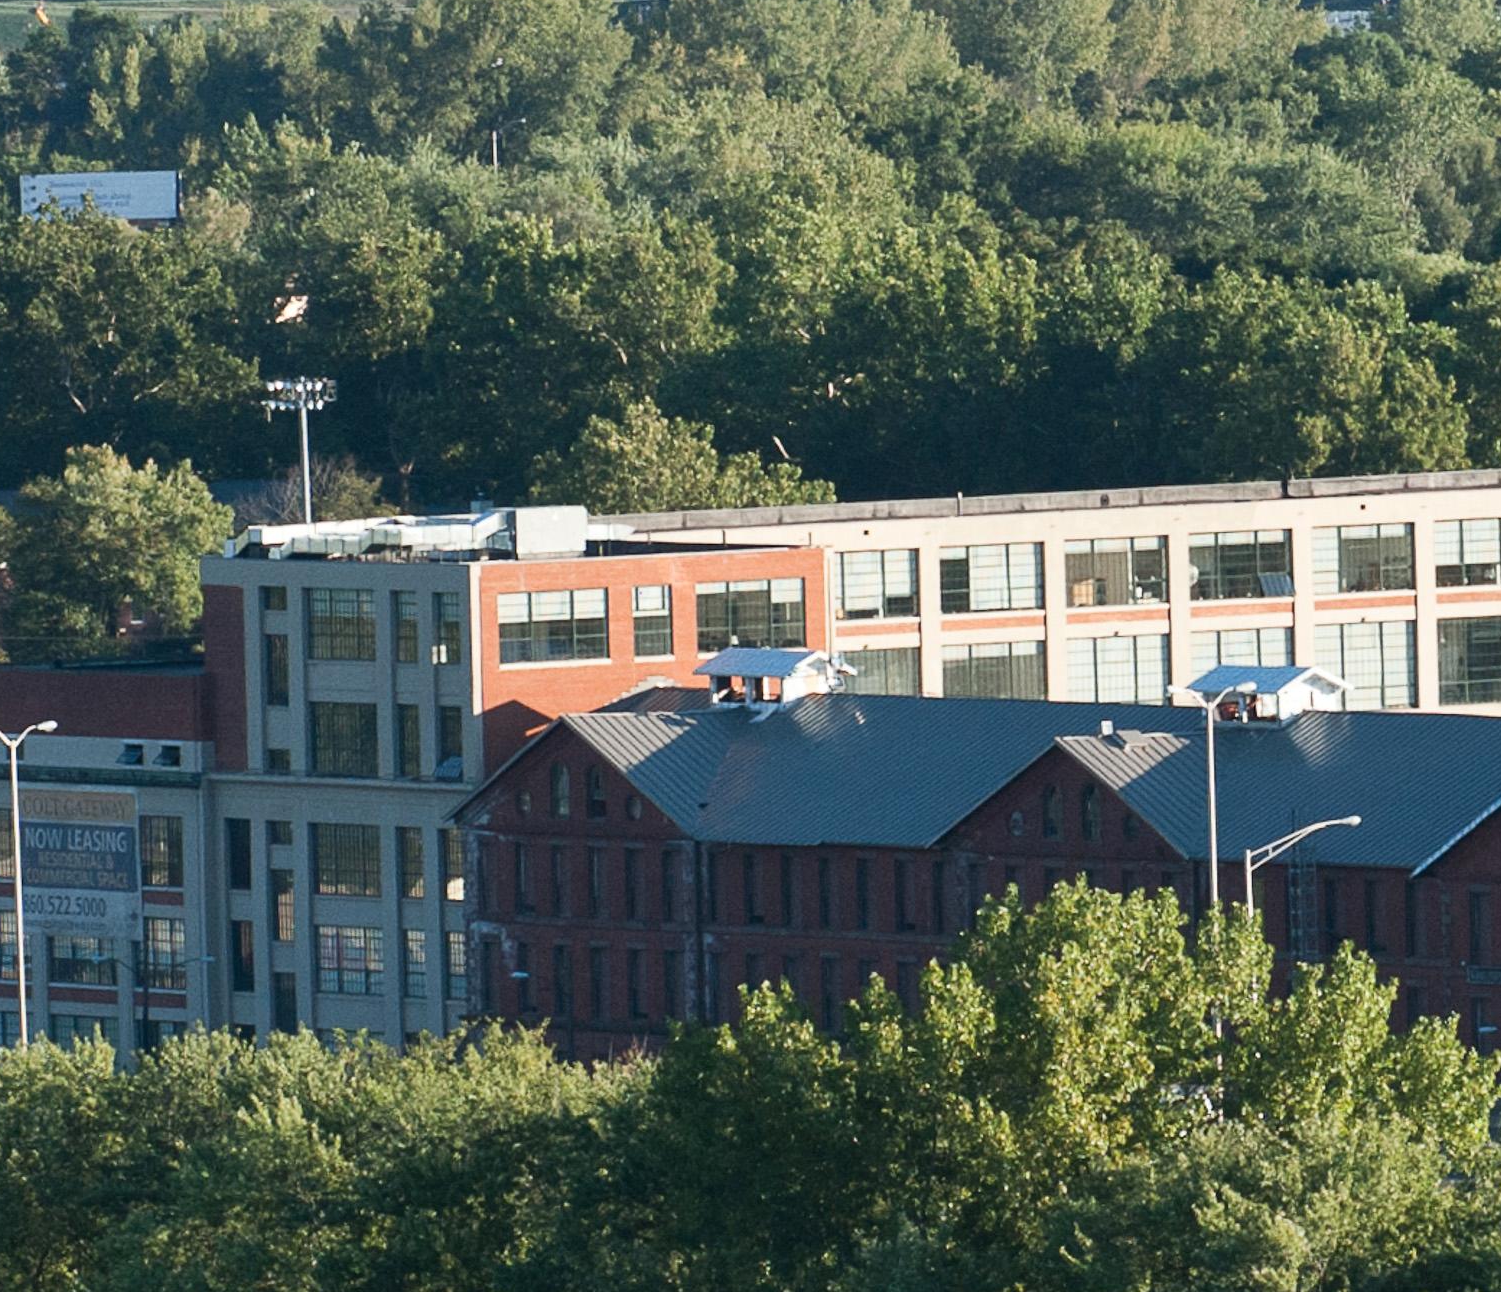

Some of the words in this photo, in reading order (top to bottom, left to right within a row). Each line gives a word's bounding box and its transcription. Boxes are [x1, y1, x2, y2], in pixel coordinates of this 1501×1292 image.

[23, 794, 61, 816] COLT
[25, 828, 63, 849] NOW
[66, 829, 128, 853] LEASING
